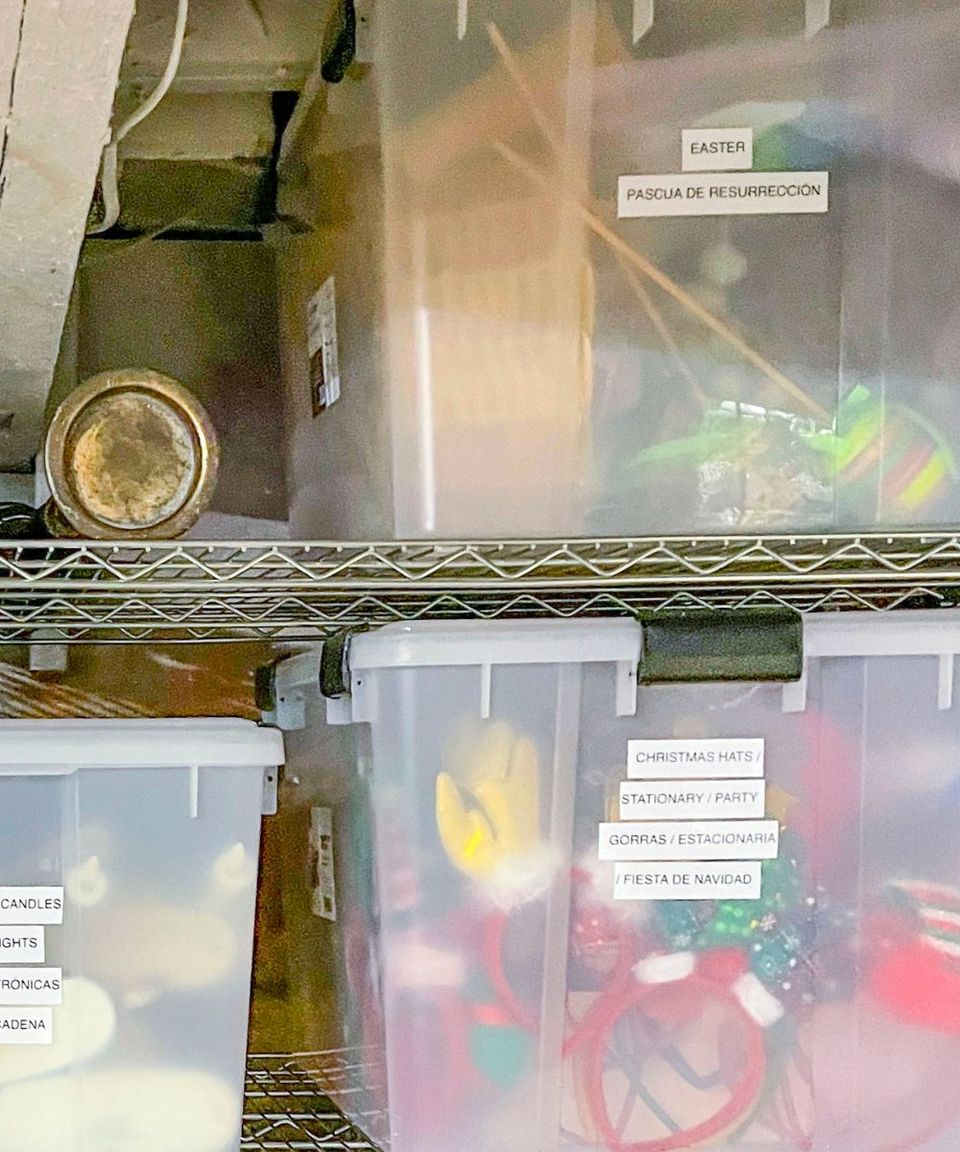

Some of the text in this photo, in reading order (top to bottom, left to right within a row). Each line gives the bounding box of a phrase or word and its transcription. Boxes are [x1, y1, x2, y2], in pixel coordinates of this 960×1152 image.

[691, 141, 745, 154] EASTER
[628, 183, 821, 200] PASCUA DE RESURRECCIÓN
[636, 752, 715, 763] CHRISTMAS
[719, 751, 753, 762] HATS
[622, 793, 704, 804] STATIONARY
[716, 792, 758, 803] PARTY
[610, 834, 666, 846] GORRAS
[679, 833, 776, 845] ESTACIONARIA
[624, 874, 668, 885] FIESTA
[673, 874, 690, 884] DE
[695, 874, 752, 884] NAVIDAD
[1, 899, 61, 909] CANDLES
